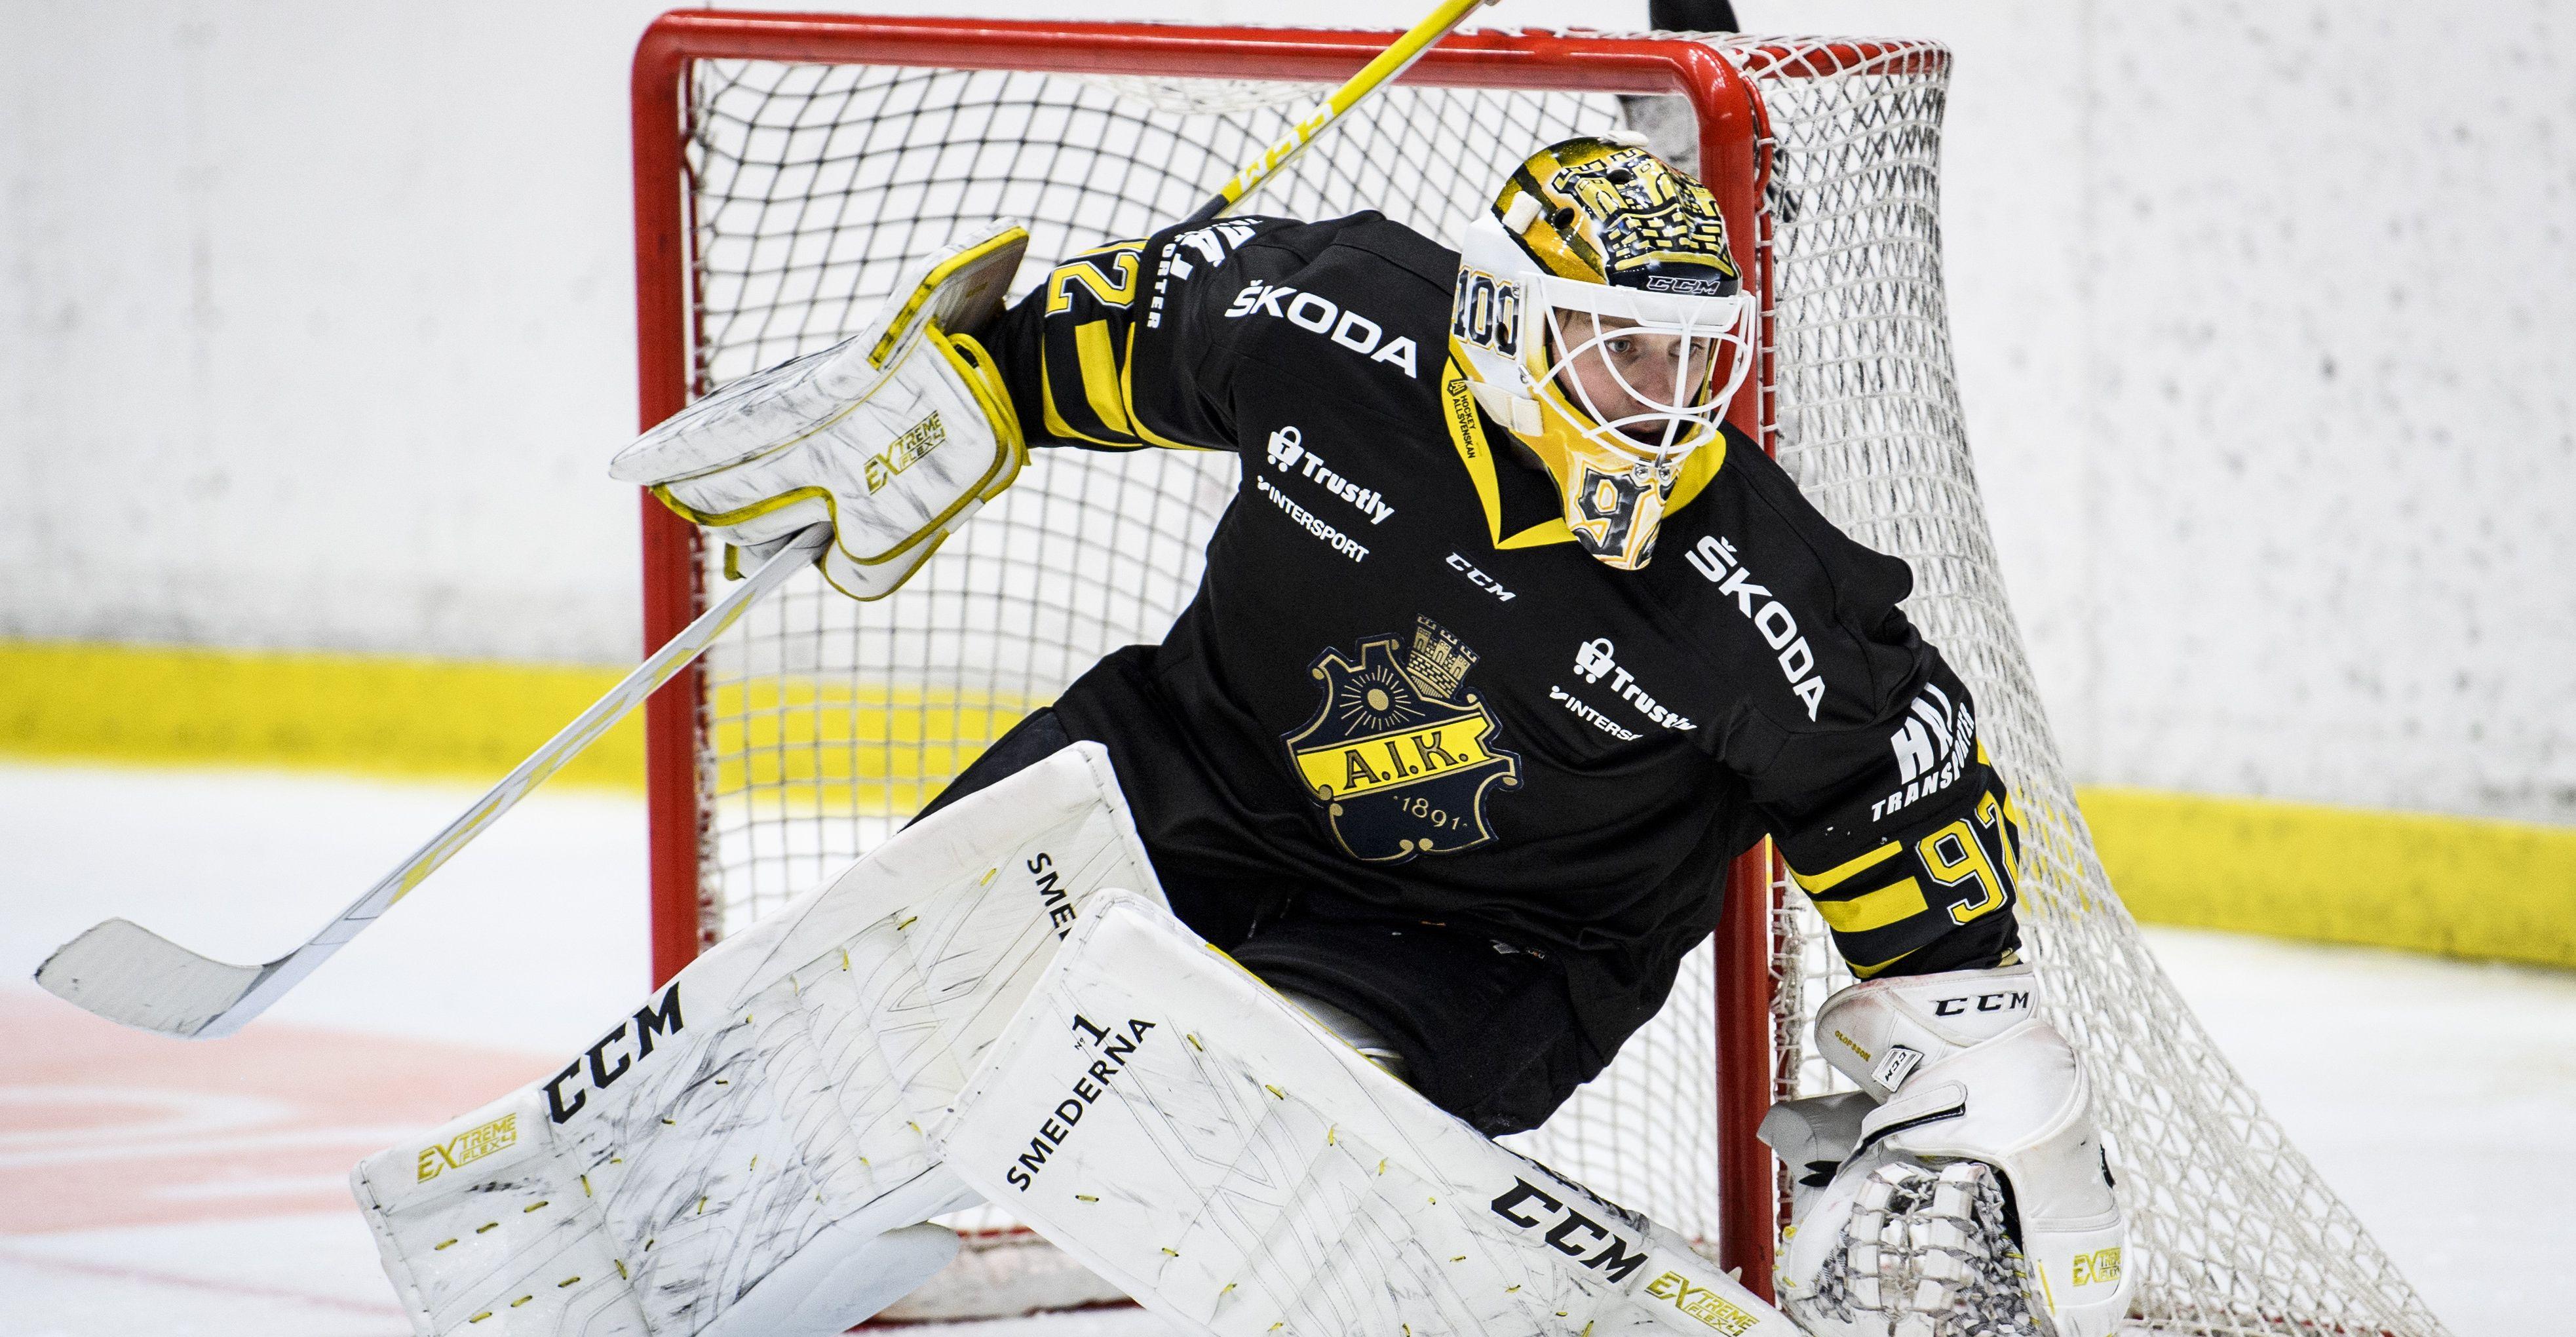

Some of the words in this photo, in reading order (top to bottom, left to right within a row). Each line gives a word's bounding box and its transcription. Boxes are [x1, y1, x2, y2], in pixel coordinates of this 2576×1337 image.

[1646, 275, 1720, 295] CCM
[1224, 279, 1417, 379] ŠKODA
[1453, 398, 1476, 459] ALLSVENSKAN
[1460, 395, 1476, 429] HOCKEY
[864, 409, 942, 495] EXTREME
[1269, 486, 1370, 562] INTERSPORT
[1302, 452, 1395, 525] Trustly
[1445, 552, 1516, 602] CCM
[1685, 535, 1827, 722] ŠKODA
[1343, 730, 1469, 790] A.I.K.
[1935, 990, 2029, 1017] CCM
[541, 980, 683, 1124] CCM
[1885, 1051, 1907, 1082] CCM
[1007, 1018, 1156, 1193] SMEDERNA
[417, 1112, 516, 1184] EXTREME
[1491, 1175, 1649, 1284] CCM
[1644, 1270, 1760, 1330] EXTREME
